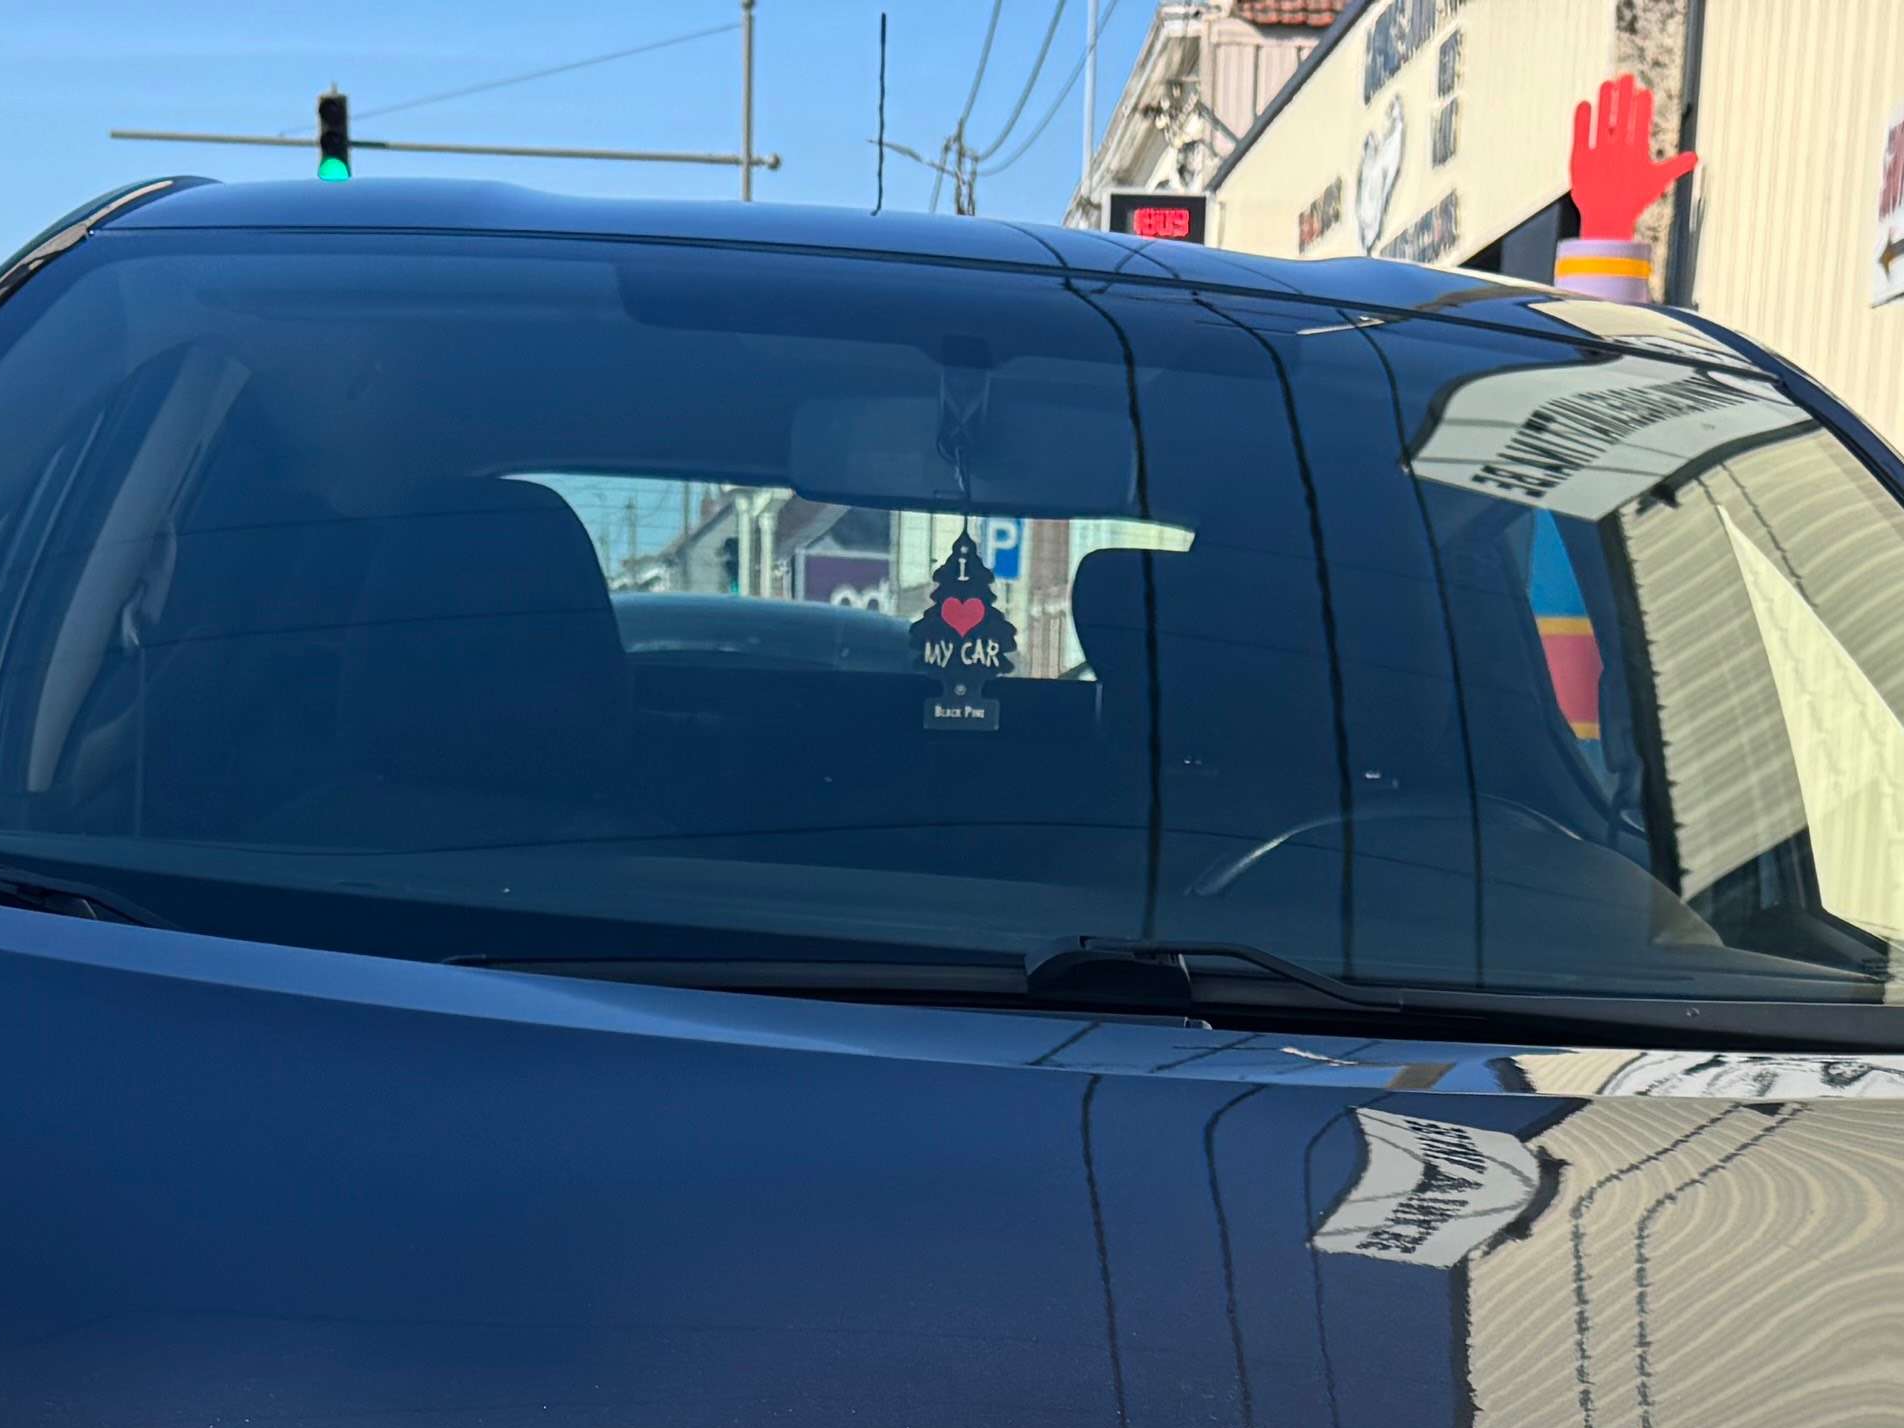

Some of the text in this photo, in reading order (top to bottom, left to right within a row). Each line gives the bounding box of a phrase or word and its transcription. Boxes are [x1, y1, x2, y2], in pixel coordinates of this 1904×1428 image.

[988, 518, 1019, 574] P
[924, 638, 1000, 668] MY CAR
